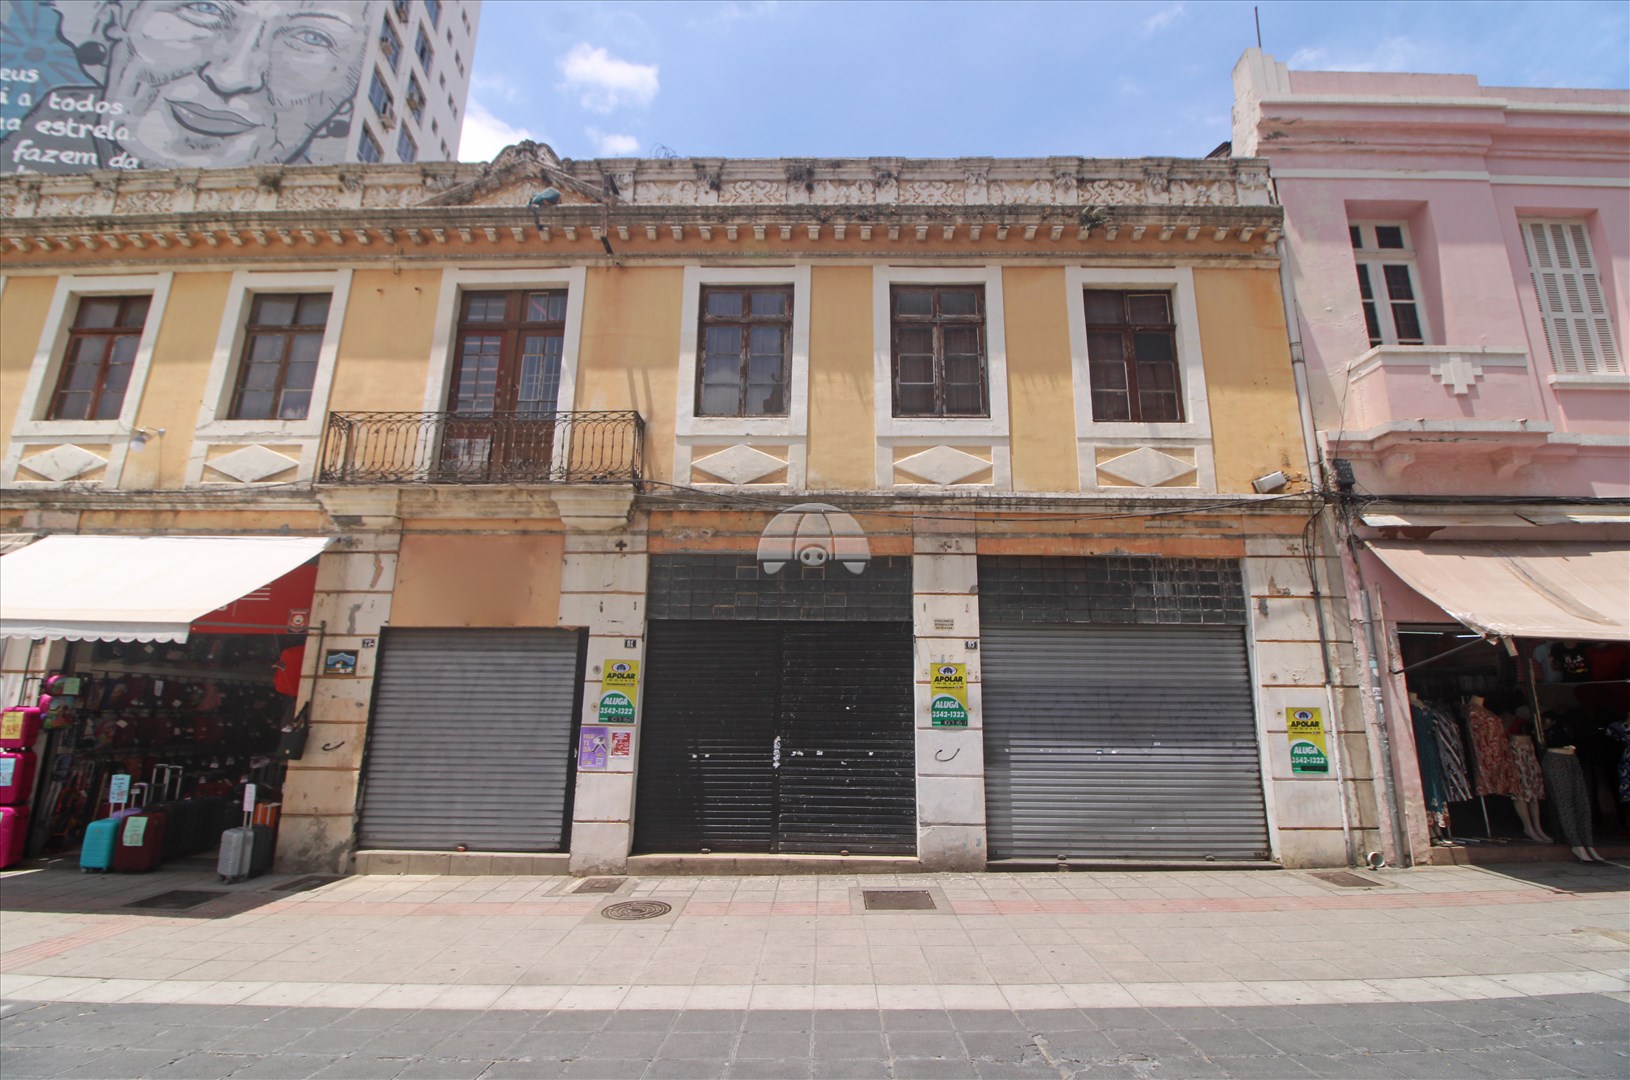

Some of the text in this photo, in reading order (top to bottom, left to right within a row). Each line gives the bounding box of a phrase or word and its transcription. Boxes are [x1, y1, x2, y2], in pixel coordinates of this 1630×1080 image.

[48, 92, 125, 115] todos
[13, 139, 138, 169] fazem da
[603, 697, 628, 705] ALUGA
[934, 701, 959, 709] ALUGA
[599, 707, 633, 715] 3542-1322
[1293, 746, 1318, 754] ALUGA
